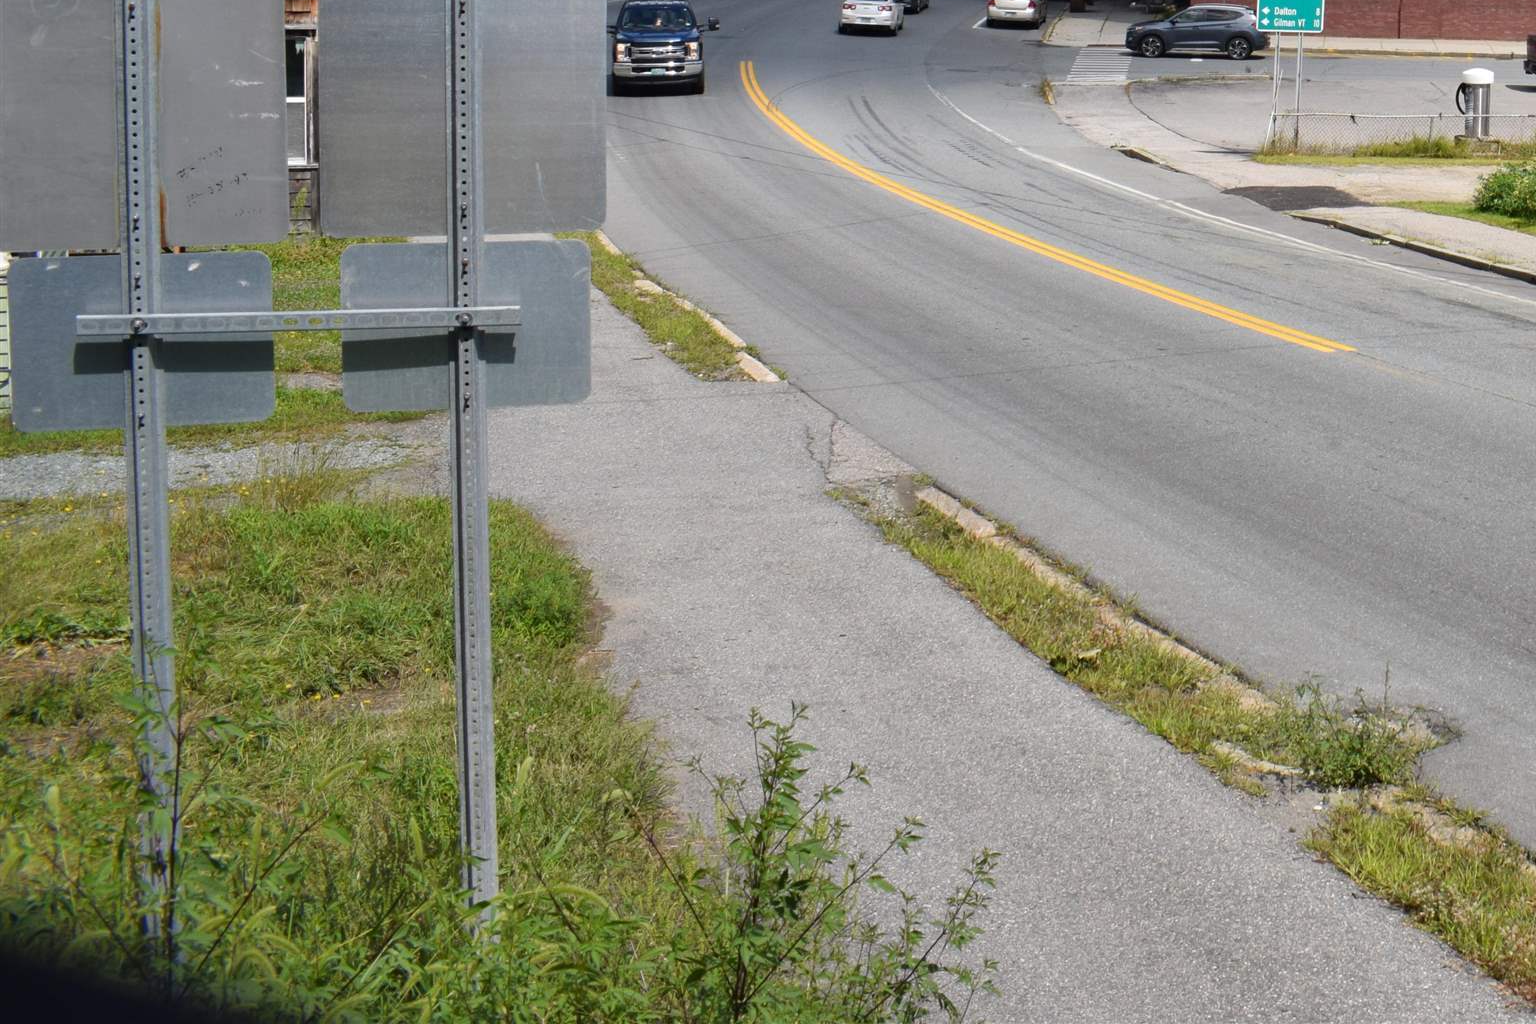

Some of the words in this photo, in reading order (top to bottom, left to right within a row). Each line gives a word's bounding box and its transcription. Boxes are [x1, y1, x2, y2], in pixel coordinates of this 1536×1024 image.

[1274, 6, 1297, 15] Dalton
[1273, 18, 1296, 27] Gilman
[1298, 19, 1306, 27] VT
[1313, 19, 1320, 27] 10
